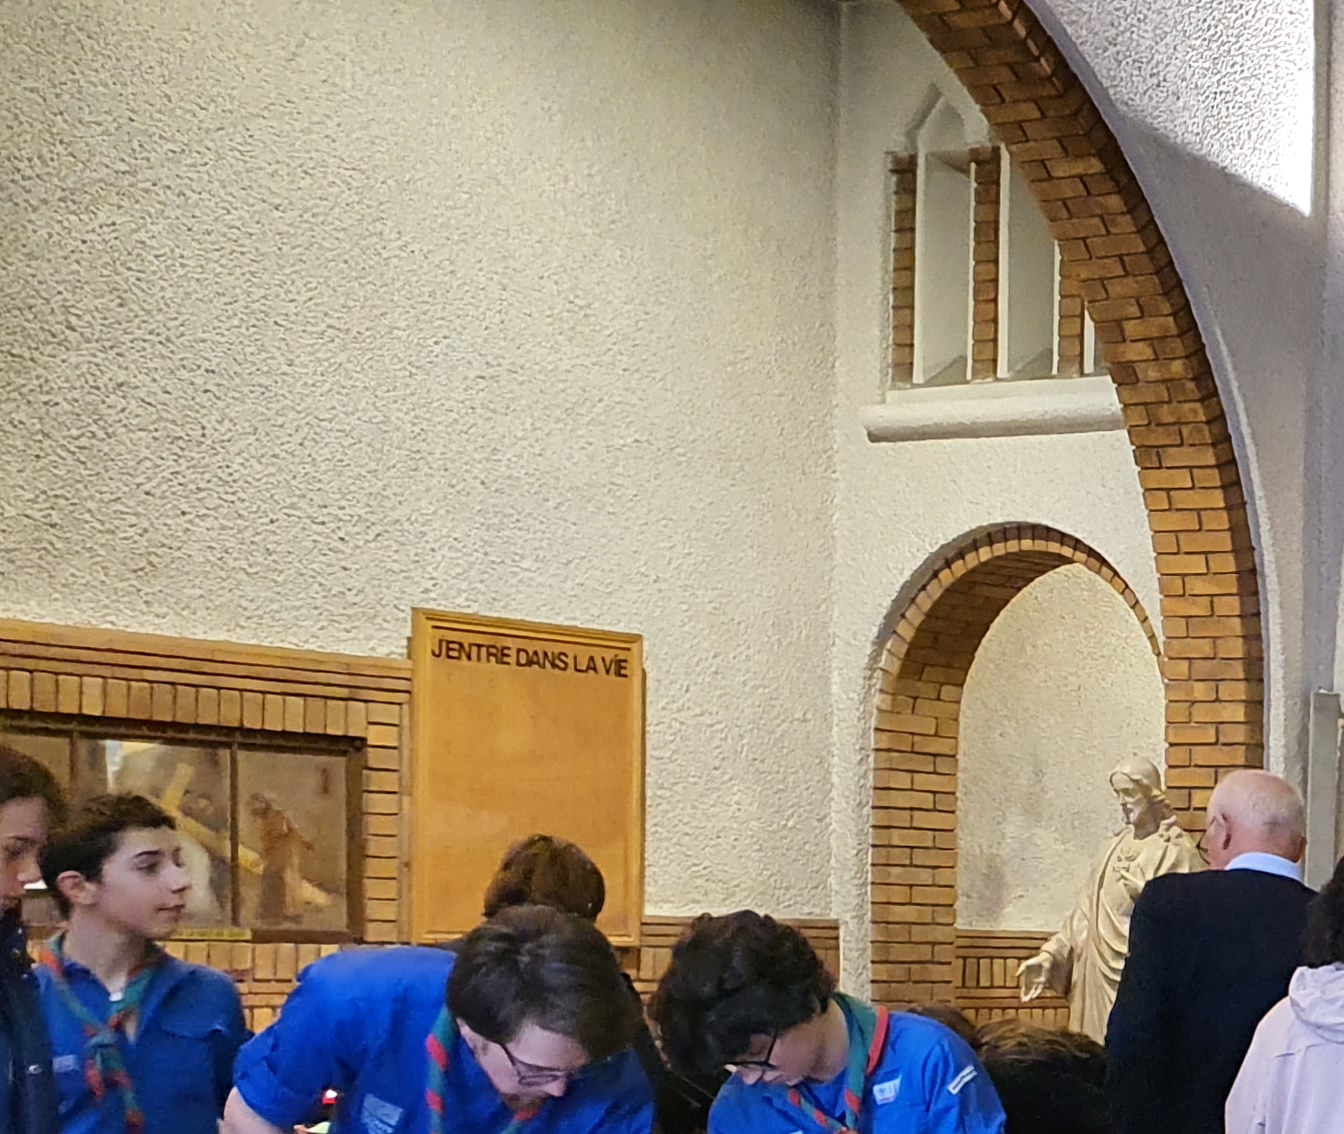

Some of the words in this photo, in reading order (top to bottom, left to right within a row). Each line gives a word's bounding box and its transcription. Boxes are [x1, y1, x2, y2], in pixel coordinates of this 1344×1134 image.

[516, 647, 569, 672] DANS
[574, 654, 599, 674] LA
[601, 653, 629, 678] VIE
